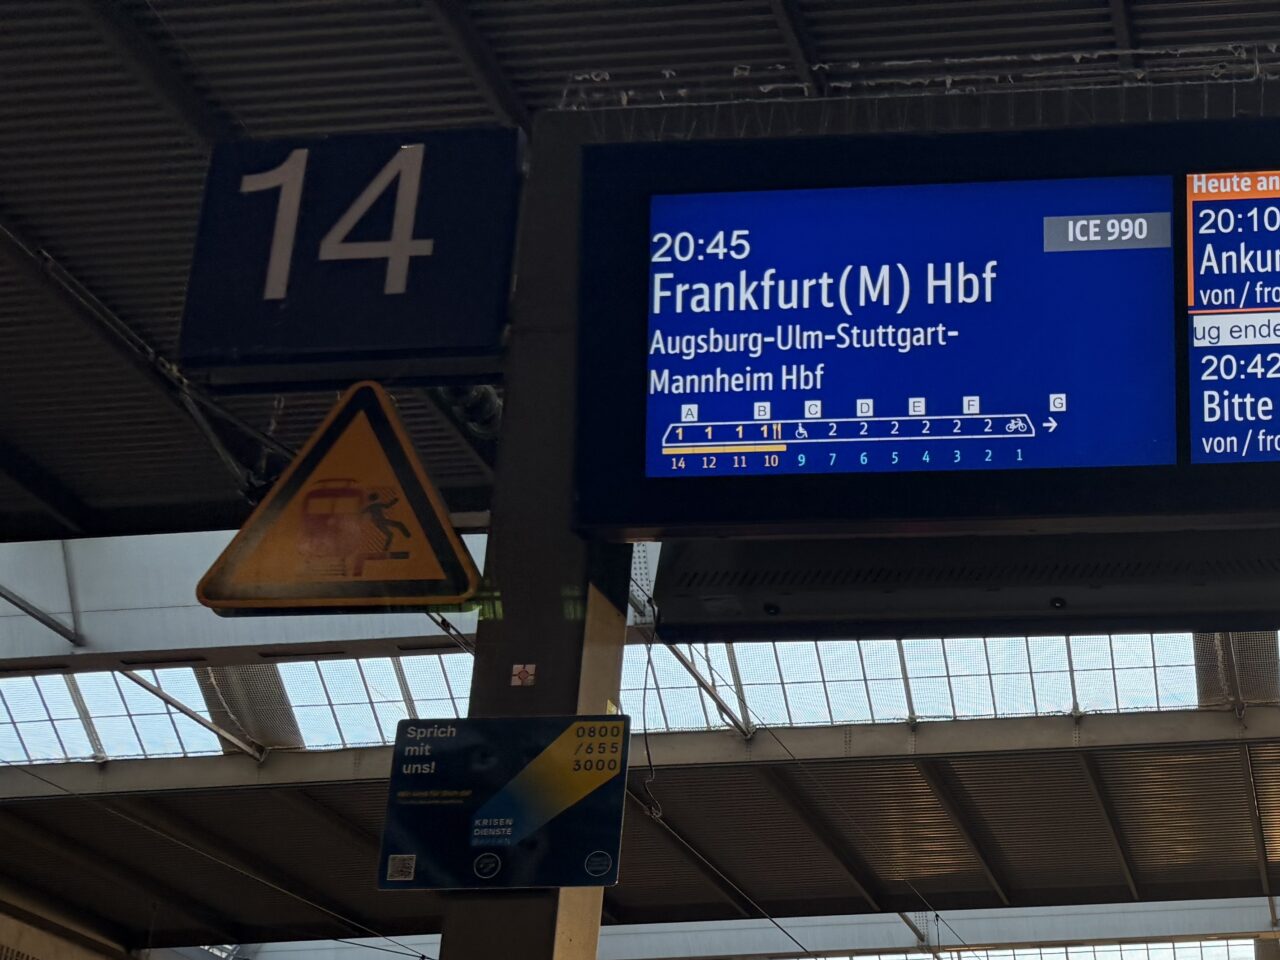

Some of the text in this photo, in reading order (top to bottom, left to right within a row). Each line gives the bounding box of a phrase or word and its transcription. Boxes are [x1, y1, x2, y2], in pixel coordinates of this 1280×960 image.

[1193, 172, 1252, 194] Heute
[1257, 173, 1280, 192] an
[240, 143, 434, 300] 14
[1199, 206, 1280, 234] 20:10
[652, 218, 1148, 262] 20:45 ICE 990
[652, 261, 998, 316] Frankfurt(M) Hbf
[1200, 287, 1236, 306] von
[1240, 282, 1250, 308] /
[649, 323, 959, 359] Augsburg-Ulm-Stuttgart-
[1194, 324, 1221, 345] ug
[649, 363, 824, 395] Mannheim Hbf
[1203, 389, 1274, 423] Bitte
[676, 419, 993, 439] 1 1 1 1 2 2 2 2 2 2
[1202, 435, 1238, 454] von
[1242, 430, 1253, 456] /
[671, 449, 1023, 469] 14 12 11 10 9 7 6 5 4 3 2 1
[406, 726, 456, 740] Sprich
[576, 726, 620, 738] 0800
[404, 743, 432, 756] mit
[402, 761, 436, 774] uns!
[572, 759, 617, 771] 3000
[473, 827, 512, 836] DIENSTE
[474, 818, 513, 826] KRISEN
